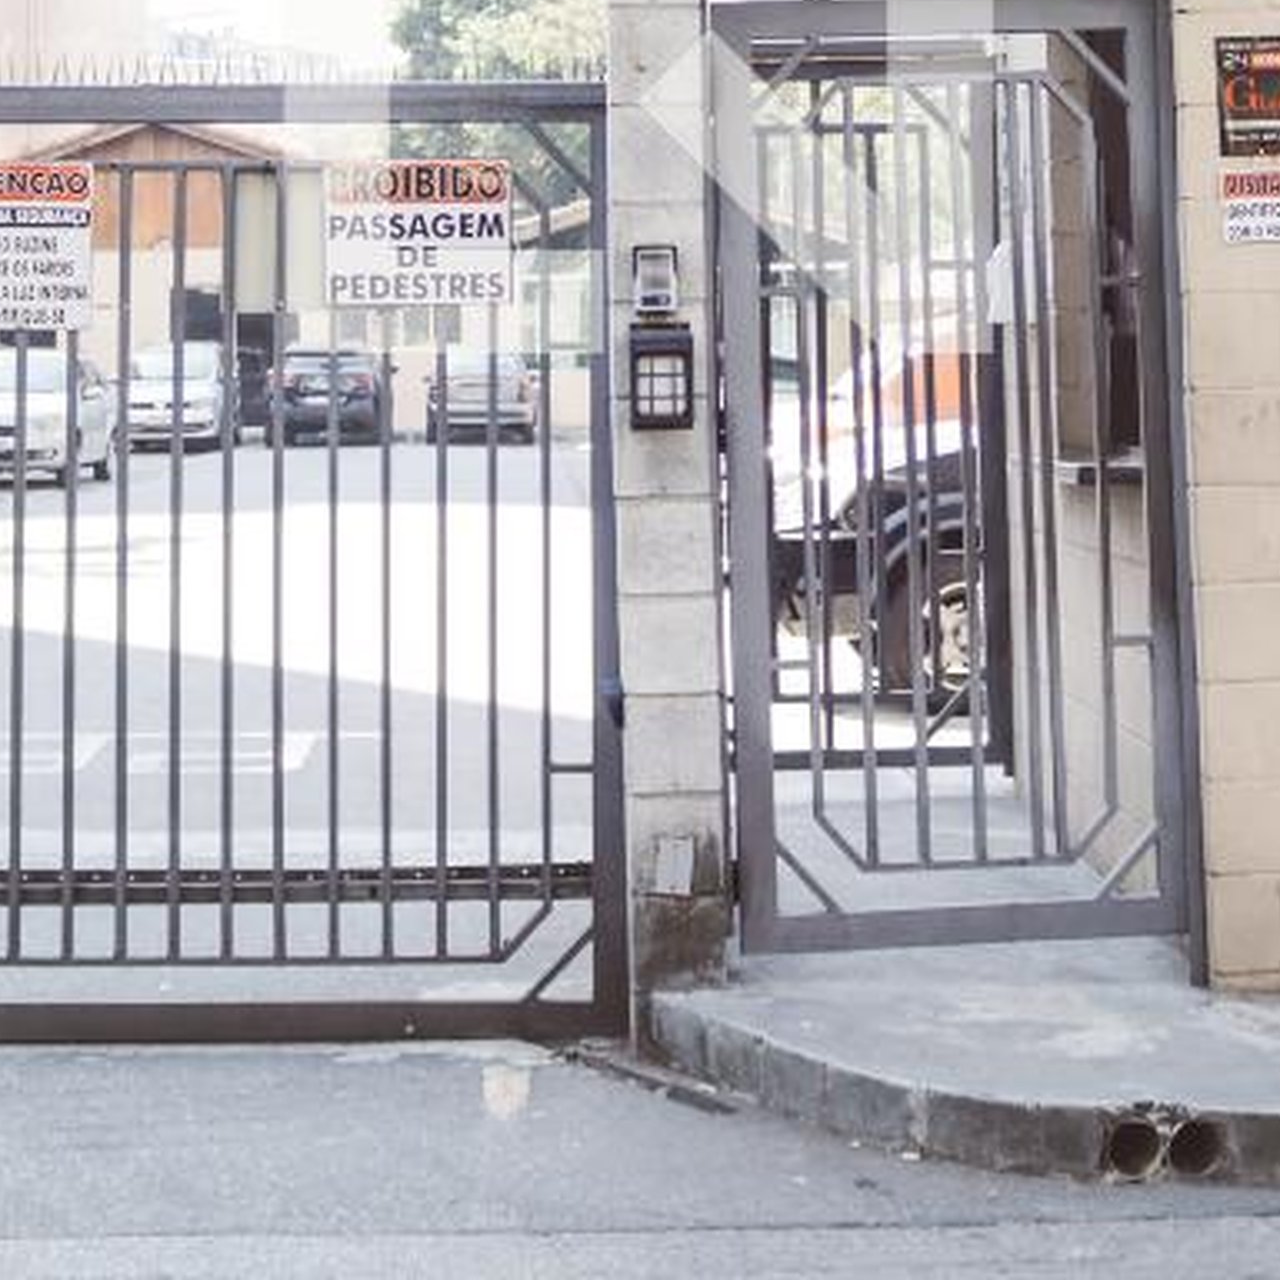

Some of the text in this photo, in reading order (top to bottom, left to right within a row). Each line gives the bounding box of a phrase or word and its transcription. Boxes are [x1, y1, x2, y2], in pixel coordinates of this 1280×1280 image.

[328, 166, 504, 199] PROIBIDO
[329, 213, 505, 241] PASSAGEM
[397, 246, 438, 268] DE
[330, 273, 505, 300] PEDESTRES
